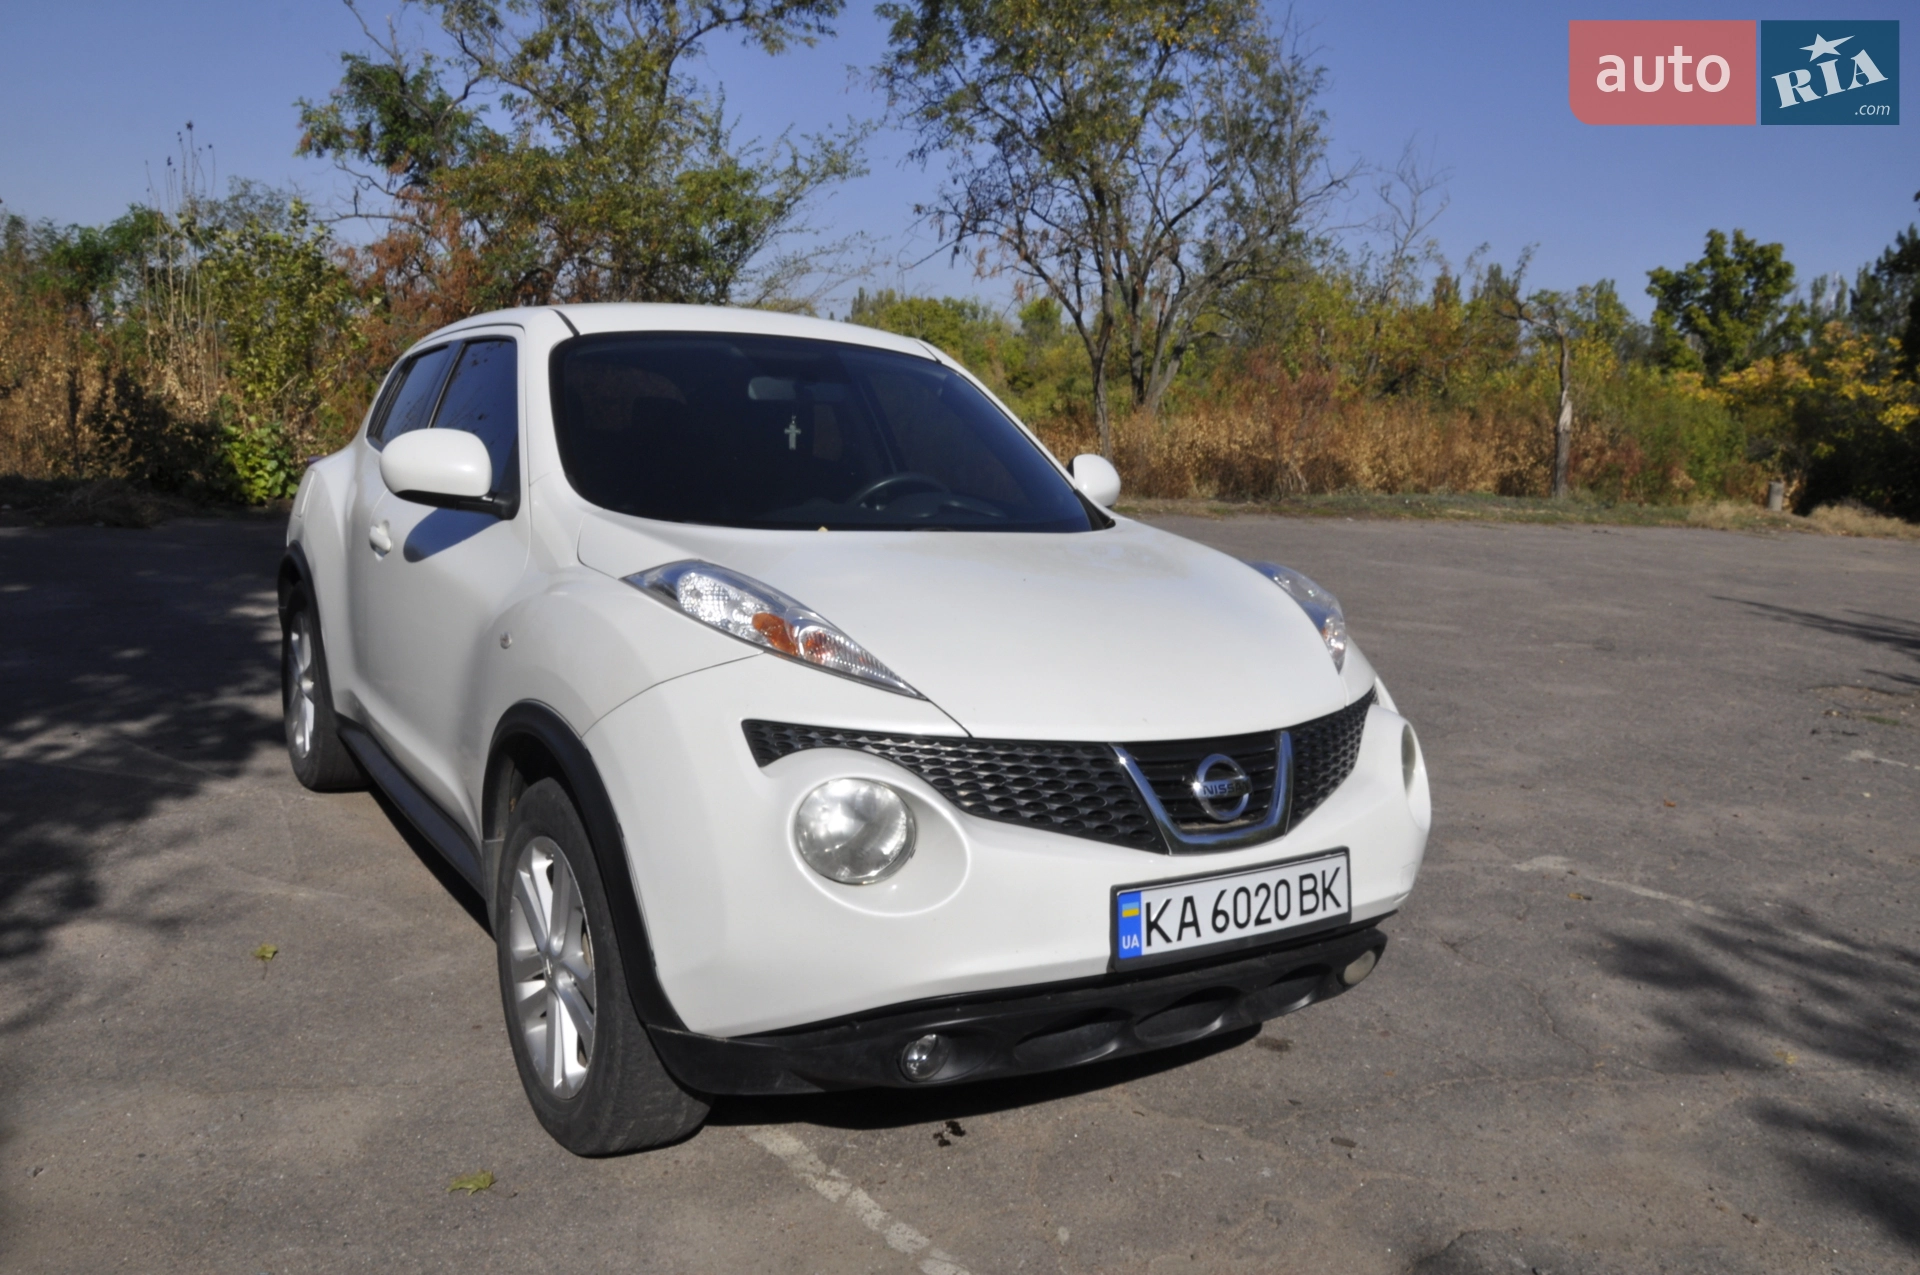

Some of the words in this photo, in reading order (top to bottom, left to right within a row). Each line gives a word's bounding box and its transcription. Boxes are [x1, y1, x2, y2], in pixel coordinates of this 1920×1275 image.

[1145, 895, 1202, 947] KA
[1211, 879, 1291, 934] 6020
[1299, 866, 1342, 917] BK
[1122, 934, 1140, 950] UA
